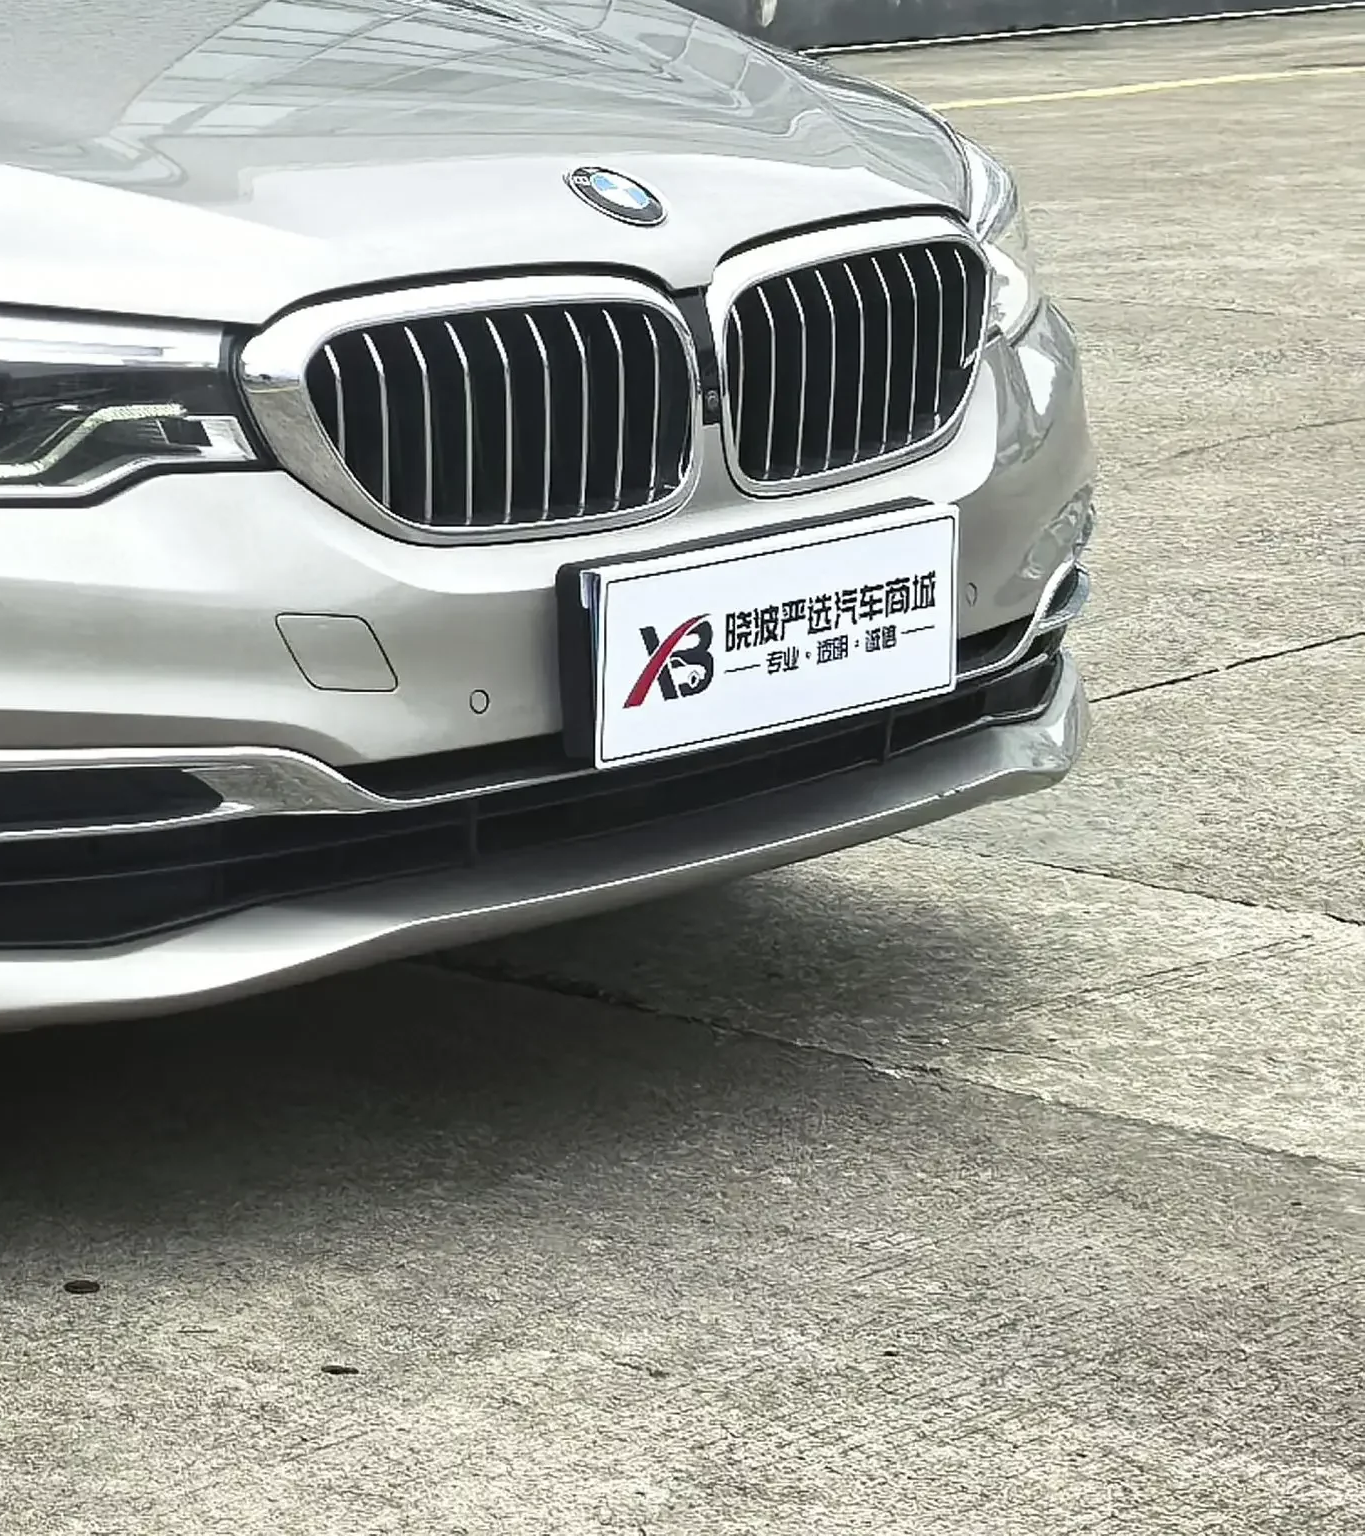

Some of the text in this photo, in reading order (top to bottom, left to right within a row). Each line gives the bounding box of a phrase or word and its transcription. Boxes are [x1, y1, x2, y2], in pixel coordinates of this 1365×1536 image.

[725, 571, 937, 652] 晓波严选汽车商城
